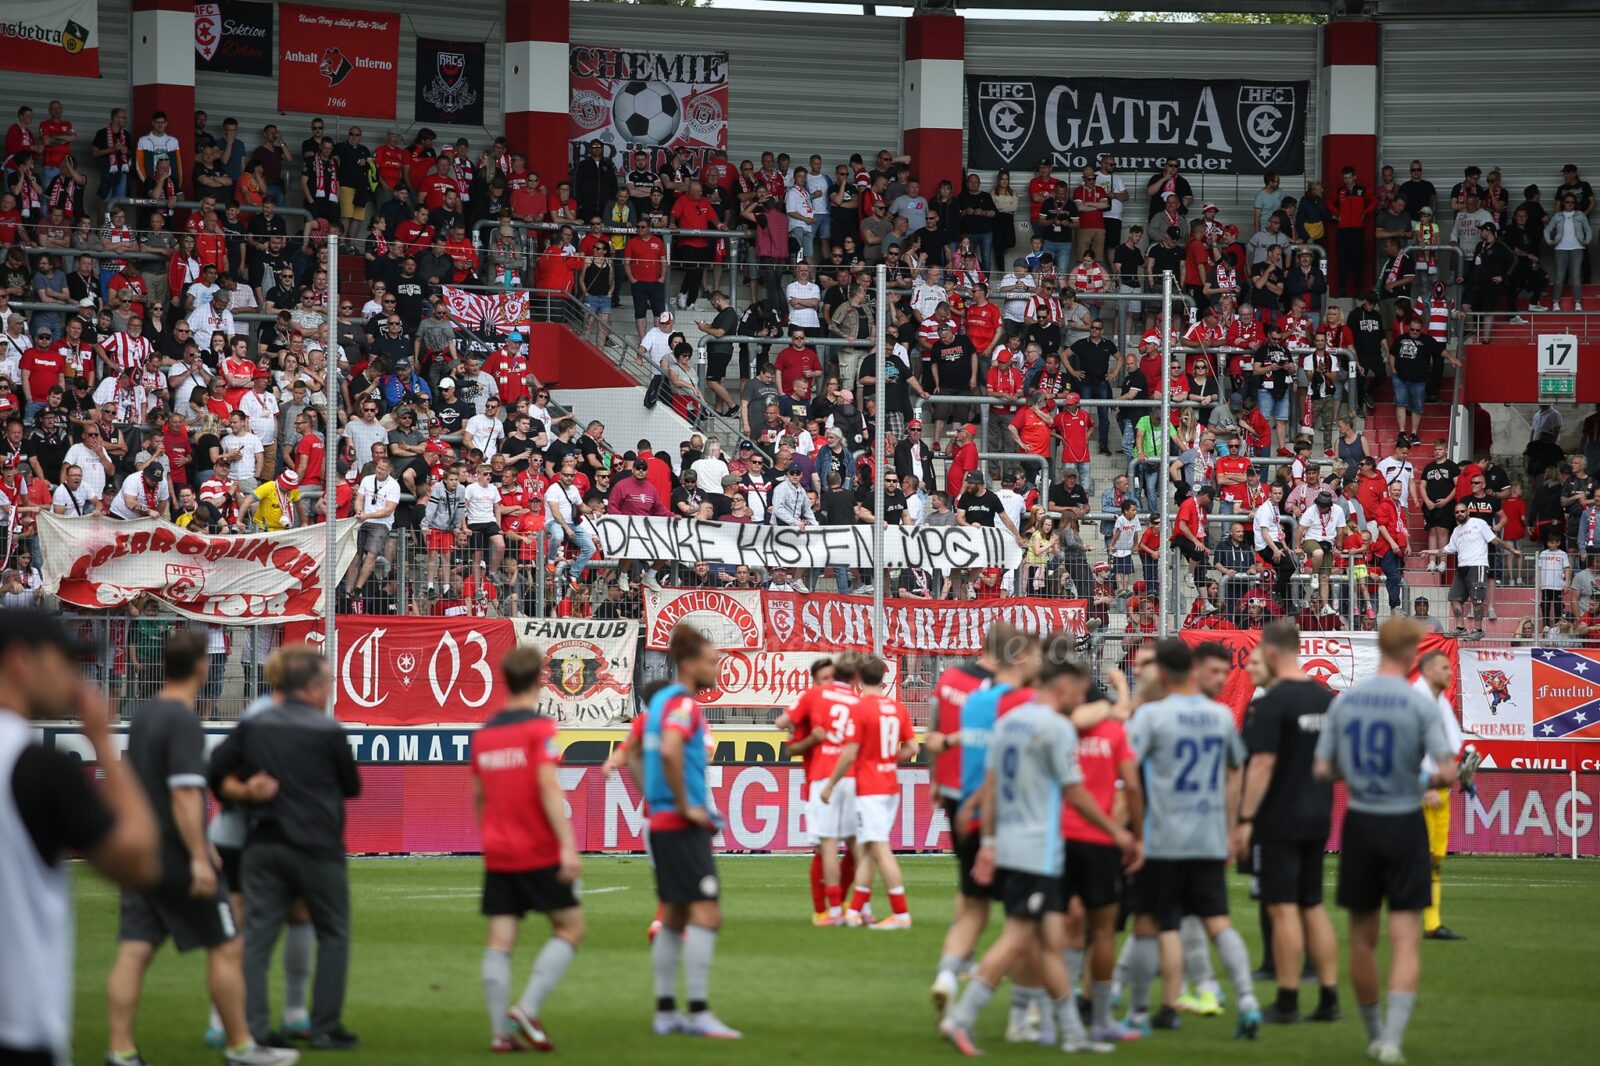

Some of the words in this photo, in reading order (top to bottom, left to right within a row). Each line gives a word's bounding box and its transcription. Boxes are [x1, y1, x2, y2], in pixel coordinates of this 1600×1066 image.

[222, 19, 266, 38] Sektion
[285, 50, 318, 64] Anhalt
[355, 57, 392, 71] Inferno
[569, 48, 725, 84] CHEMIE
[327, 97, 347, 108] 1966
[988, 85, 1024, 98] HFC
[1248, 89, 1285, 102] HFC
[1051, 152, 1093, 168] No
[1096, 152, 1233, 170] Surrender
[1545, 343, 1572, 366] 17
[596, 515, 725, 563] DANKE
[737, 522, 876, 568] KASTEN
[202, 592, 290, 617] TOUR
[771, 600, 789, 608] HFC
[524, 621, 628, 639] FANCLUB
[653, 591, 758, 648] MARATHONTOR
[428, 629, 493, 708] 03
[1536, 684, 1594, 700] Fanclub
[826, 704, 850, 744] 3
[1343, 717, 1395, 777] 19
[1002, 745, 1020, 802] 9
[1174, 737, 1224, 792] 27
[1511, 757, 1567, 769] SWH
